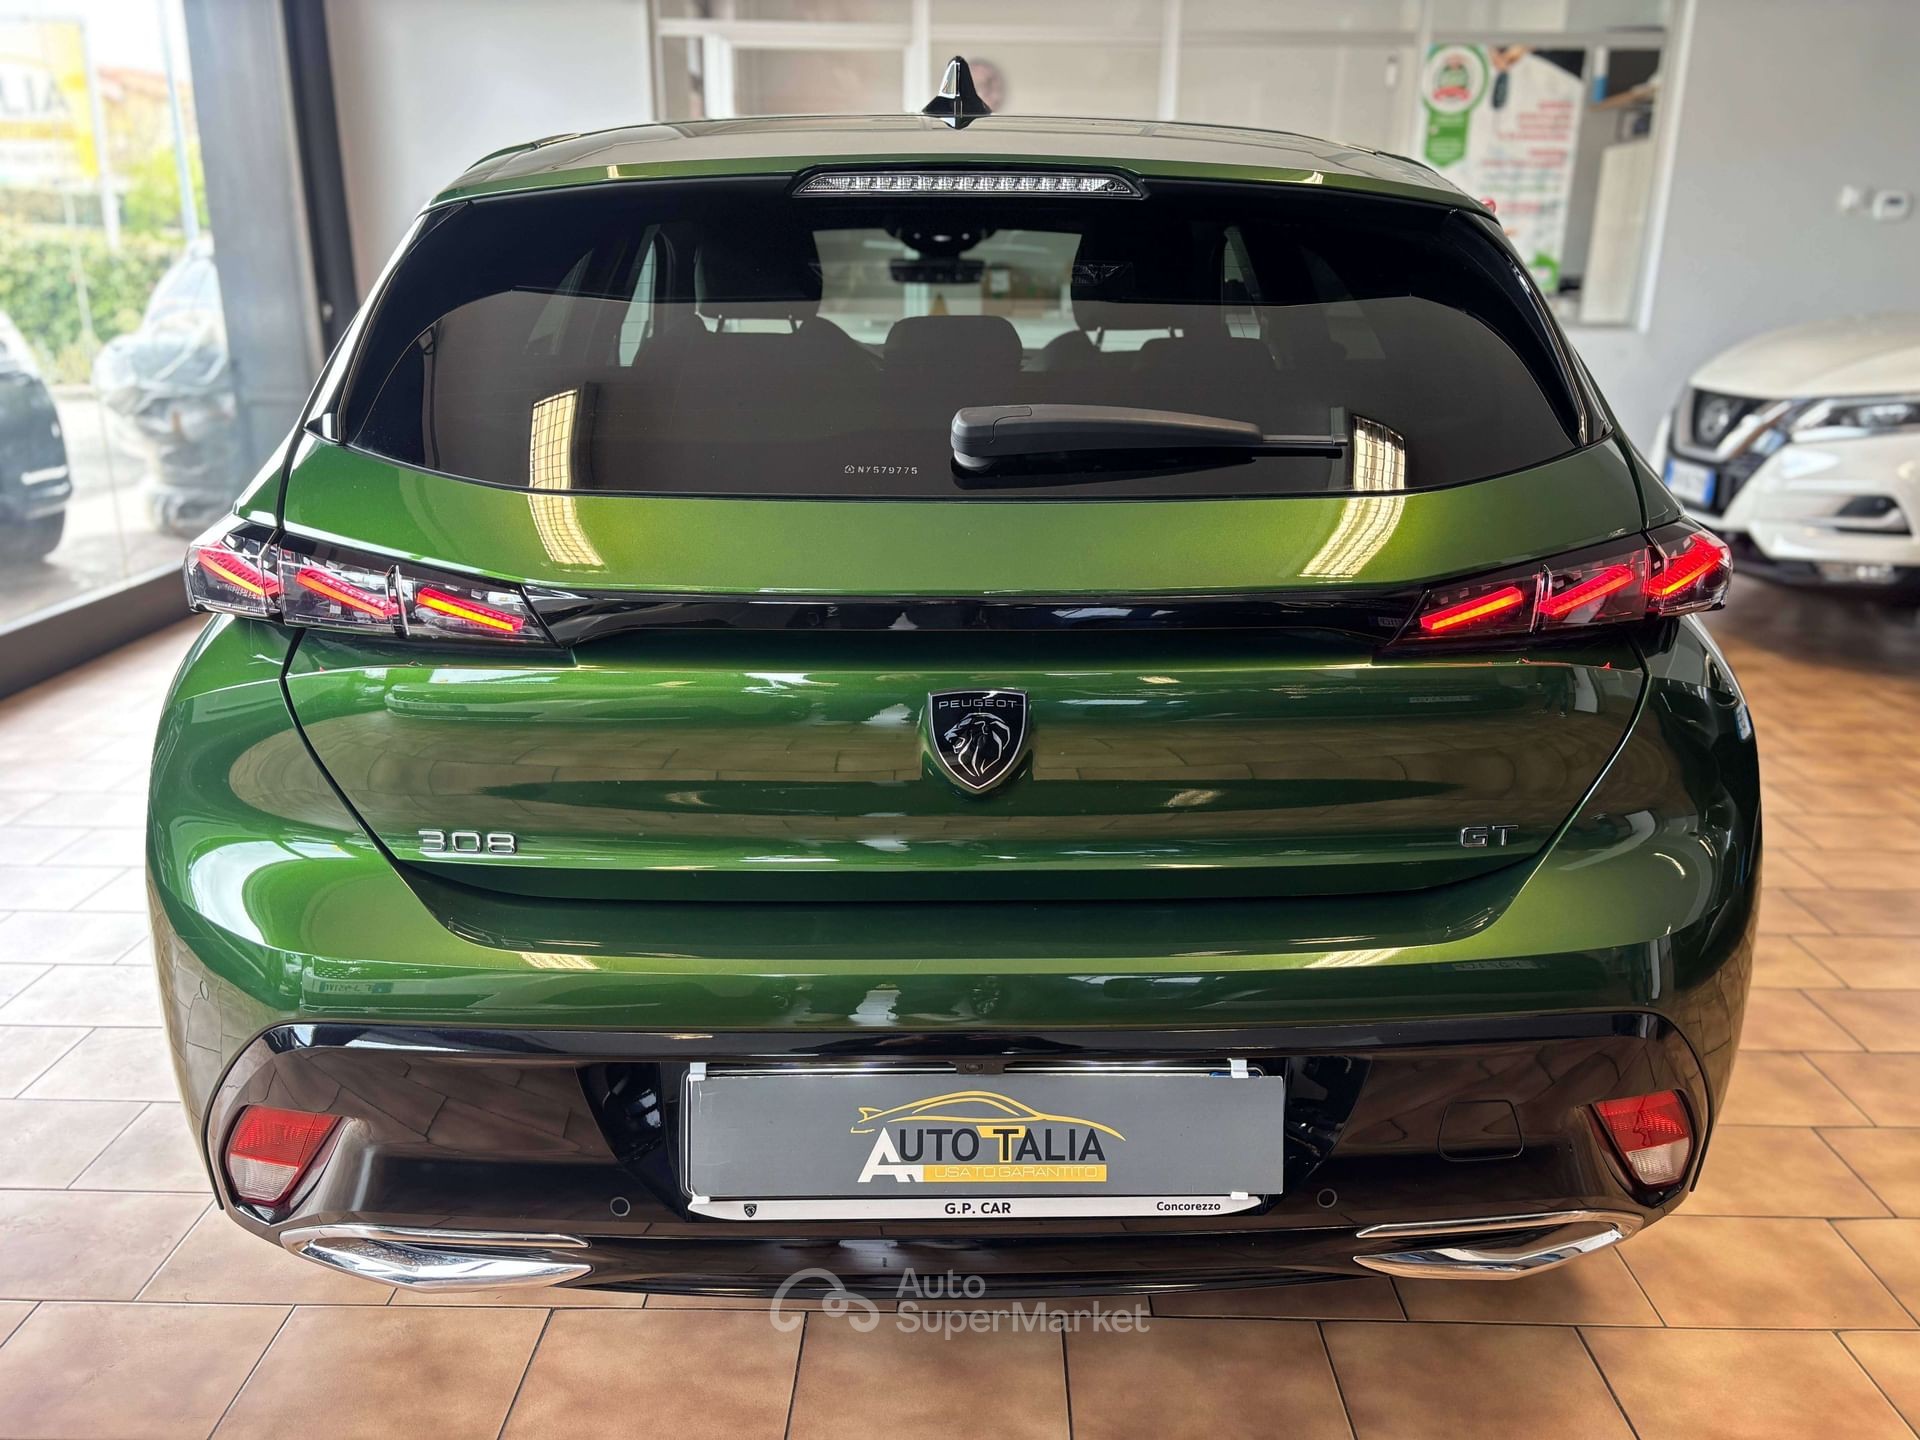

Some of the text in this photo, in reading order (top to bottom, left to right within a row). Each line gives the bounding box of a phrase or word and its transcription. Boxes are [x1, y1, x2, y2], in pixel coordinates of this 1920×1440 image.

[938, 698, 1017, 710] PEUGEOT
[418, 829, 517, 854] 308
[1461, 825, 1519, 848] GT
[858, 1125, 1106, 1183] AUTO TALIA
[934, 1165, 1098, 1178] USATO GARANTITO
[944, 1202, 1011, 1215] G.P. CAR
[1156, 1201, 1221, 1212] Concorezzo
